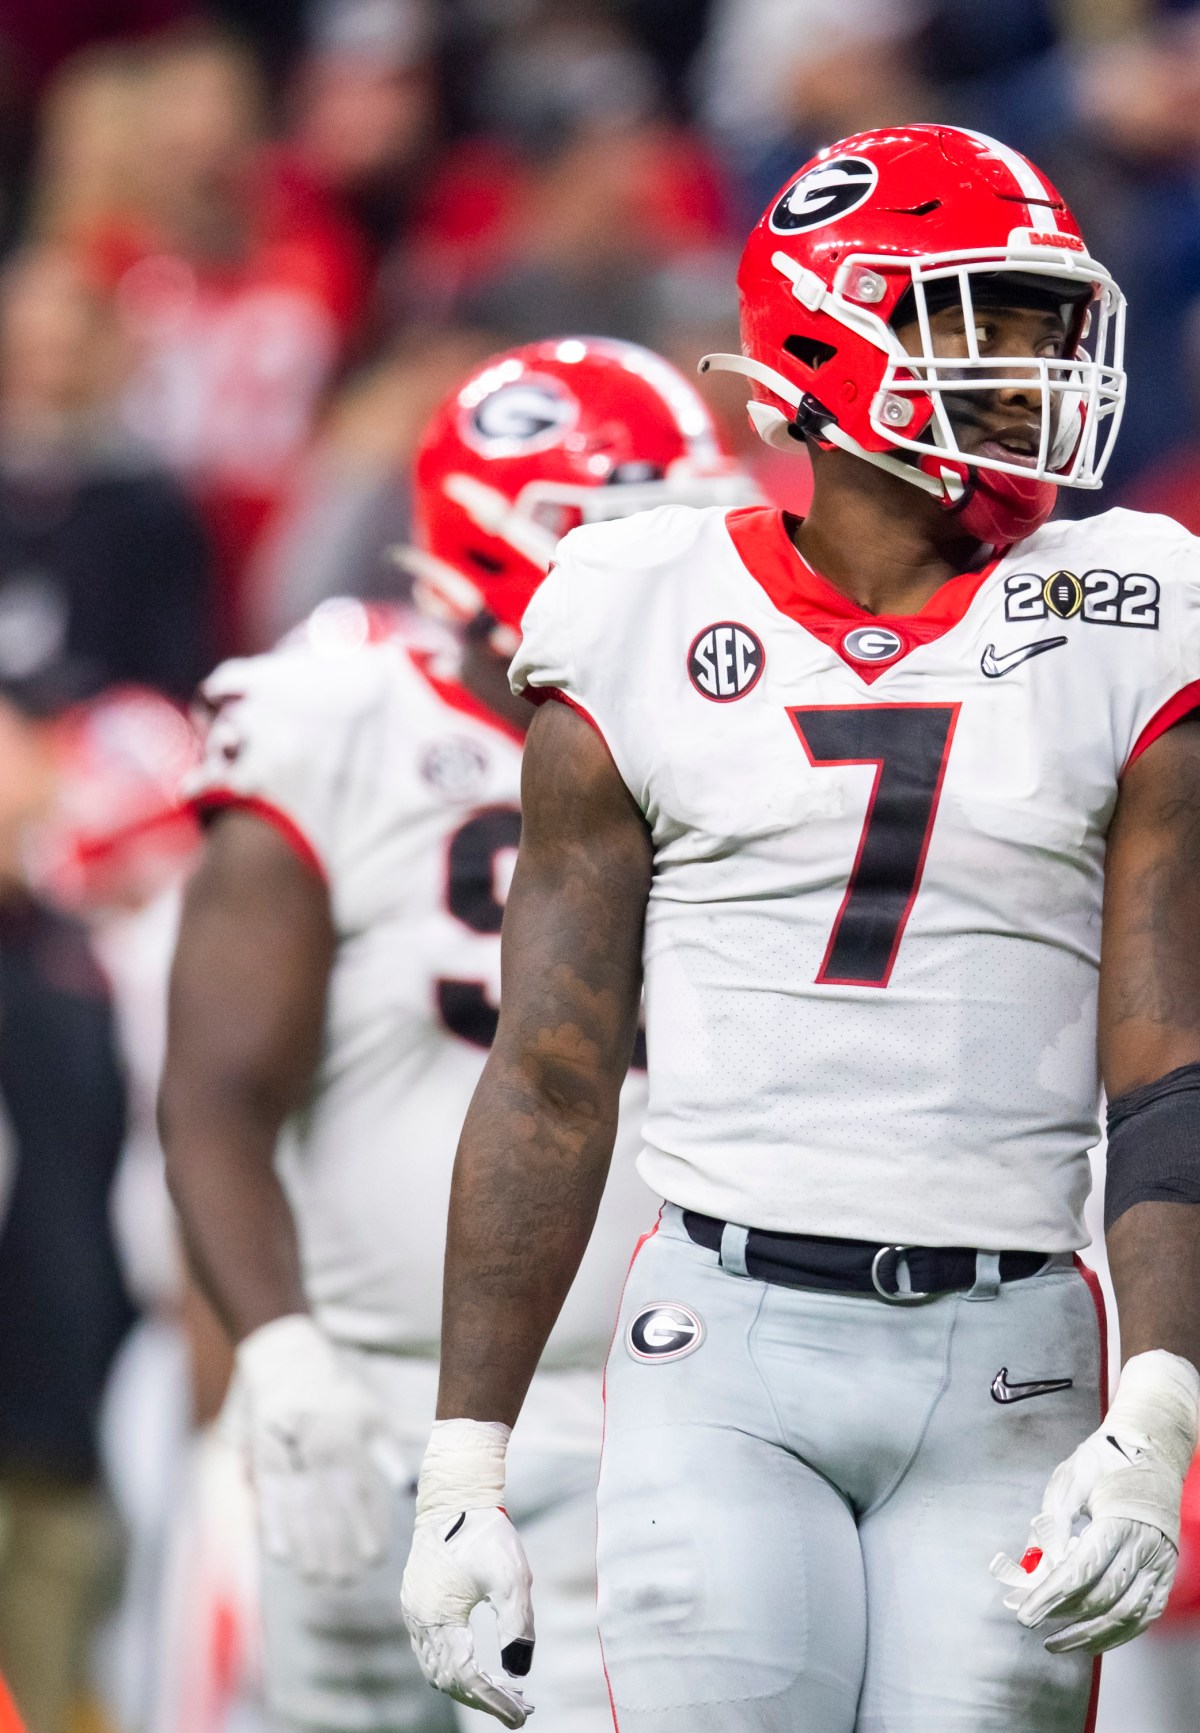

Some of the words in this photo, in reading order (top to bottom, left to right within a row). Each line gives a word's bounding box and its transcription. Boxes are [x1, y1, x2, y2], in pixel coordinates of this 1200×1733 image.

[770, 155, 877, 234] G
[694, 627, 757, 696] SEC
[843, 627, 901, 660] G
[783, 701, 963, 989] 7
[628, 1304, 700, 1358] G
